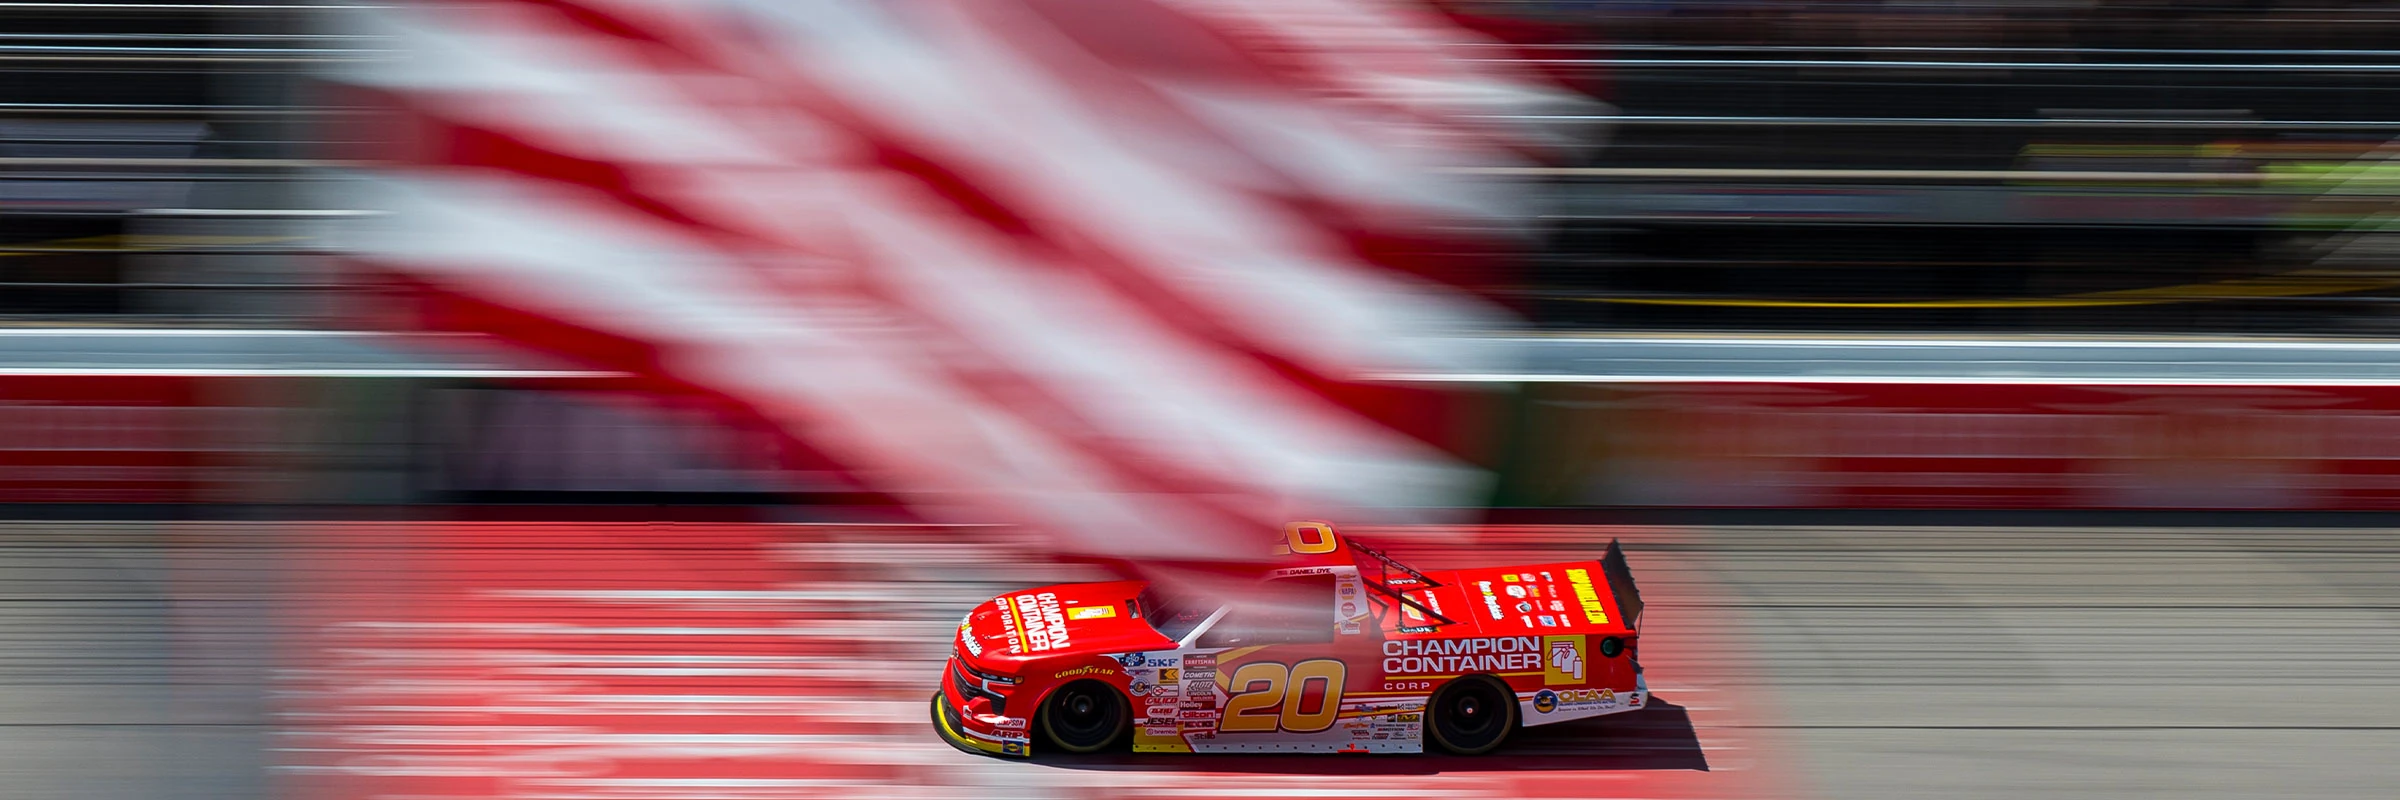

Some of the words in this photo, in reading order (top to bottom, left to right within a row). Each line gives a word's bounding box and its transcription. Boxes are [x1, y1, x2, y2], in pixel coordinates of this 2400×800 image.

[1015, 594, 1050, 652] CONTAINER
[1037, 592, 1071, 650] CHAMPION
[1382, 636, 1540, 656] CHAMPION
[1147, 658, 1178, 667] SKF
[1382, 653, 1542, 673] CONTAINER
[1054, 665, 1115, 679] GOODYEAR
[1190, 681, 1213, 689] KLOTZ
[1384, 682, 1431, 690] CORP
[1218, 657, 1347, 734] 20
[1558, 688, 1616, 703] OLAA
[992, 730, 1024, 739] ARP
